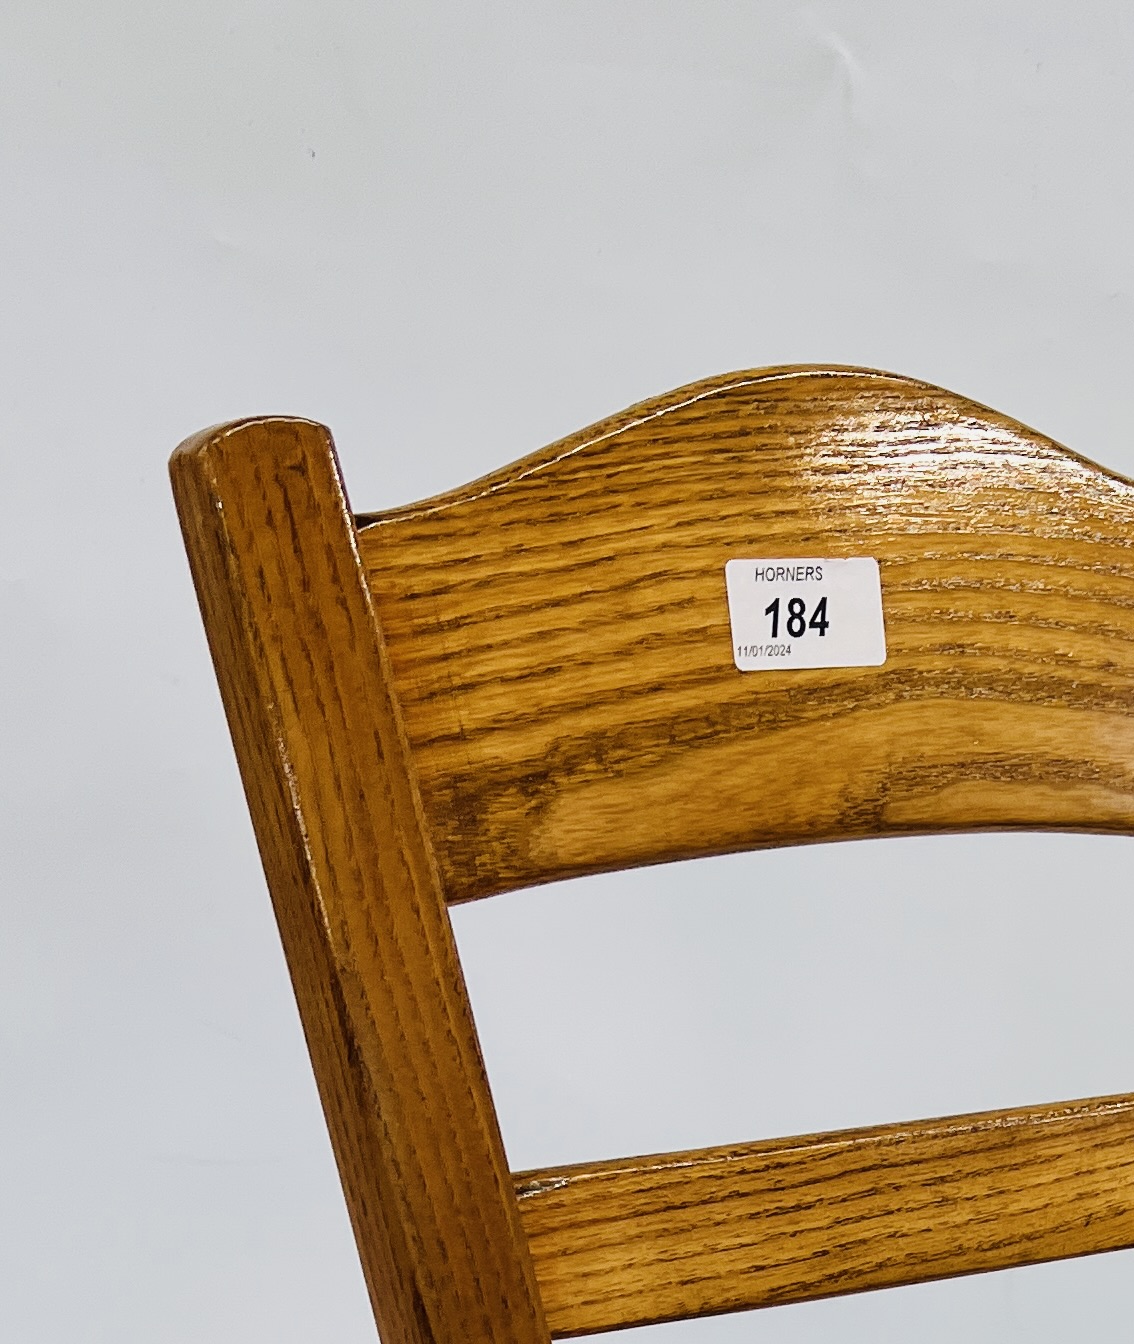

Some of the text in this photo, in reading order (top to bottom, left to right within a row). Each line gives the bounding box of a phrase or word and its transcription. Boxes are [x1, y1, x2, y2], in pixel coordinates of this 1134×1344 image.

[755, 565, 823, 582] HORNERS
[764, 596, 830, 639] 184
[737, 644, 792, 658] 11/01/2024
